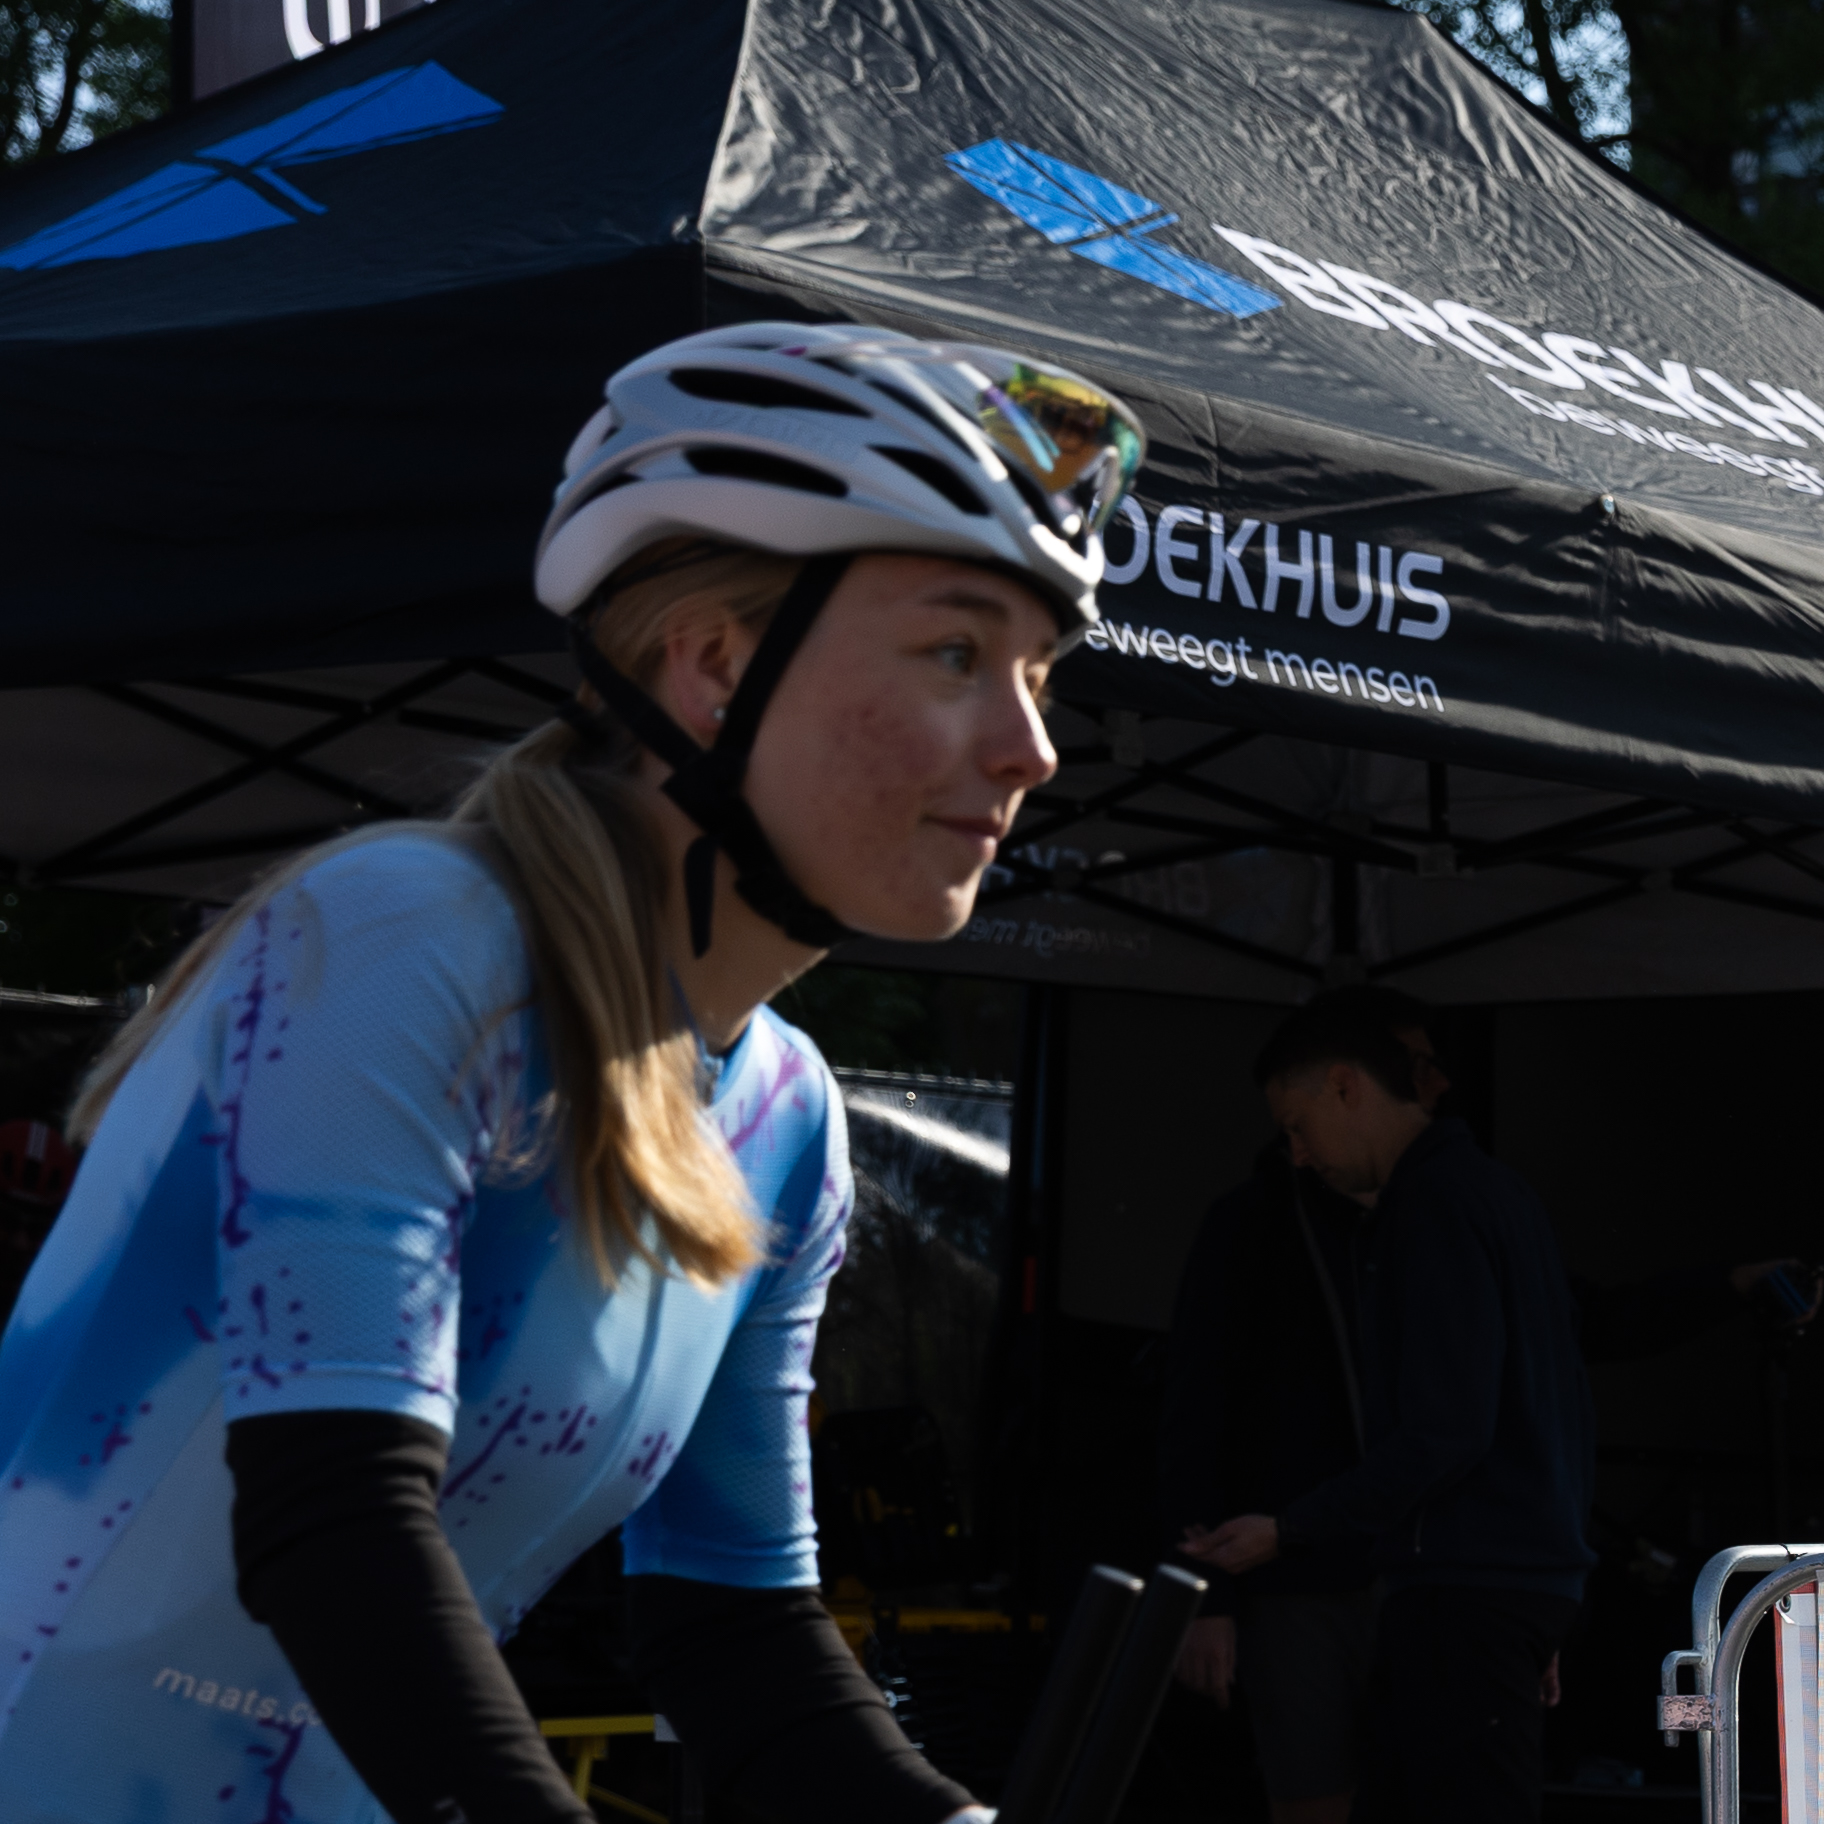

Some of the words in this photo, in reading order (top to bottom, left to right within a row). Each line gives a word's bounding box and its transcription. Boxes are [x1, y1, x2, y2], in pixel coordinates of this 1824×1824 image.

[1088, 496, 1451, 641] OEKHUIS
[1084, 617, 1259, 688] eweegt
[1264, 648, 1445, 713] mensen
